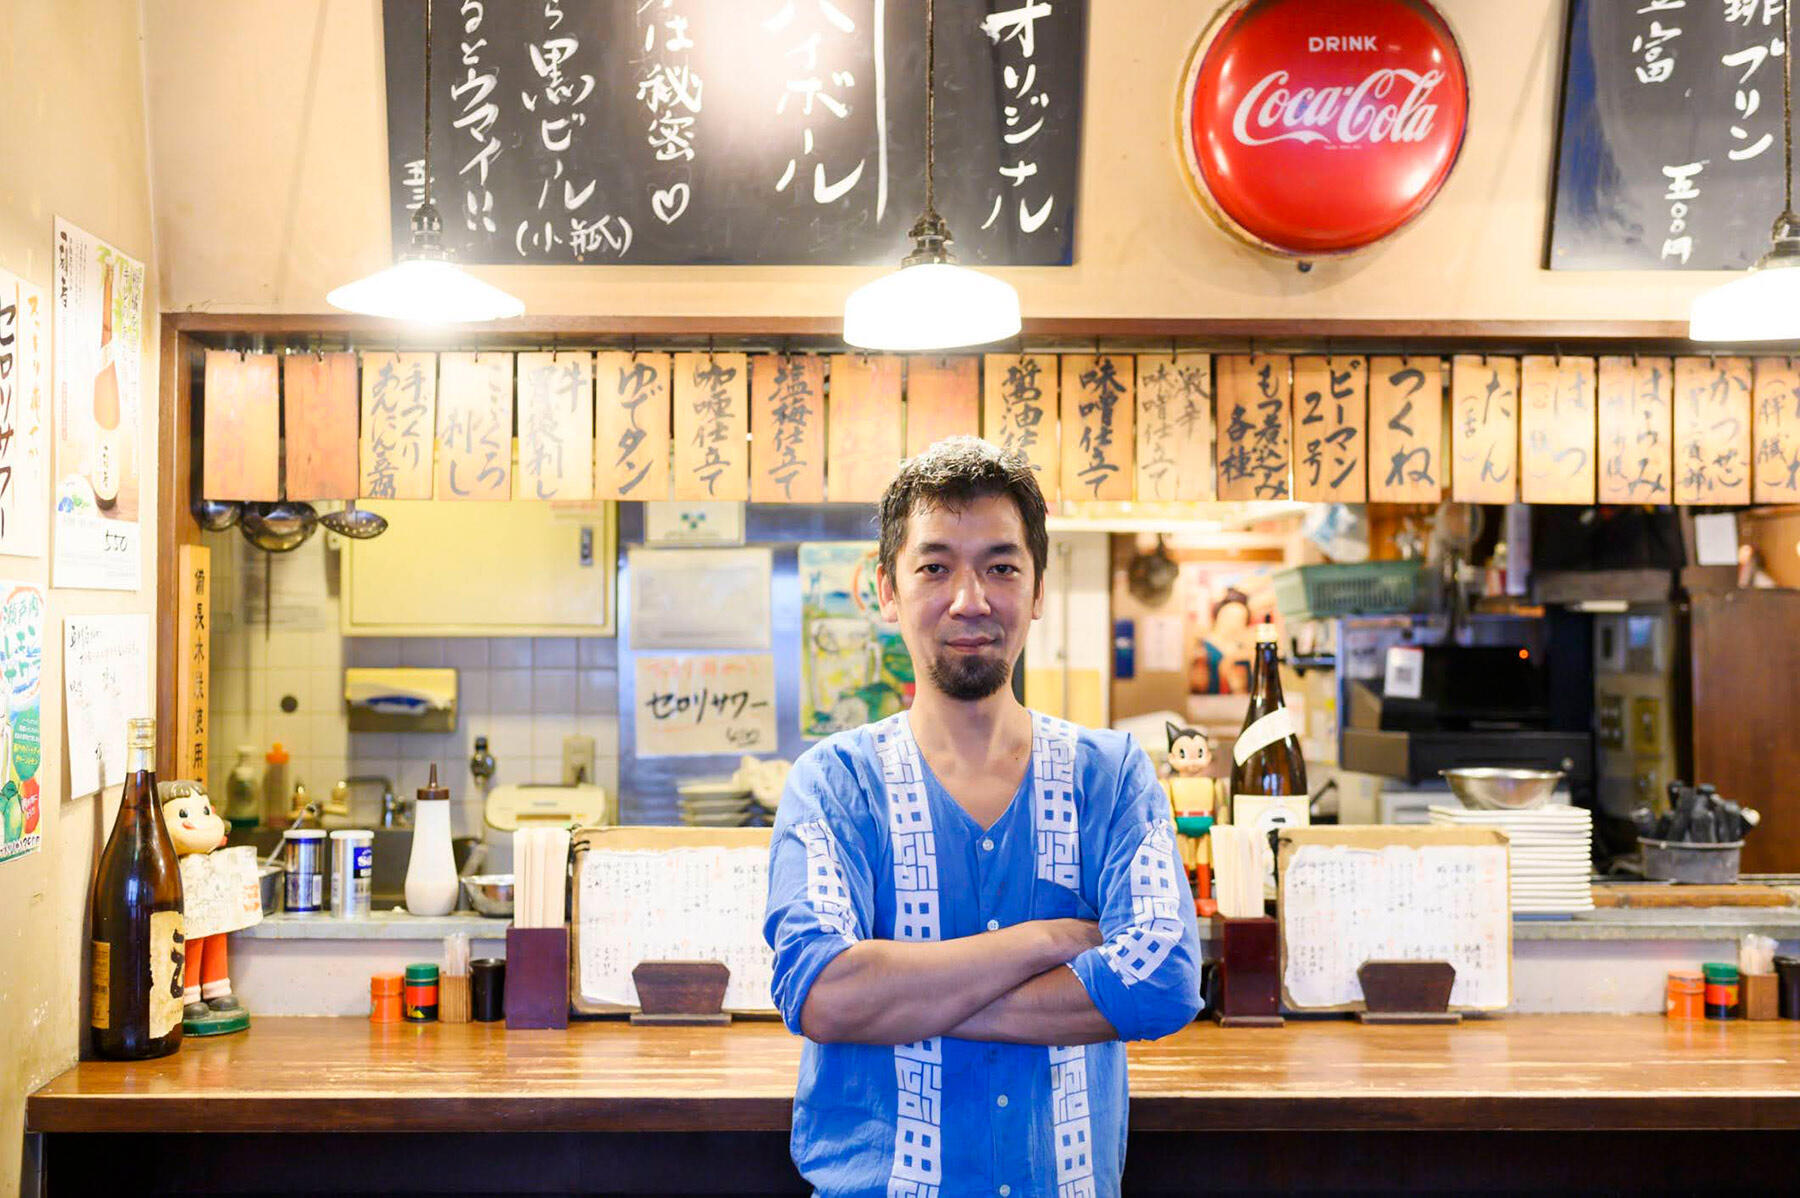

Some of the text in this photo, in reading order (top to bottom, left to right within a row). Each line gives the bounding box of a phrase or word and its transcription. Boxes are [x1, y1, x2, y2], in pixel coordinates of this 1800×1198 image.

[1308, 36, 1378, 52] DRINK
[978, 0, 1054, 233] オリジナル
[616, 362, 663, 495] ゆでタン
[1077, 358, 1127, 498] 味噌仕立て
[1325, 360, 1361, 489] ピーマン
[1385, 368, 1435, 487] つくね
[646, 687, 769, 723] セロリサワー
